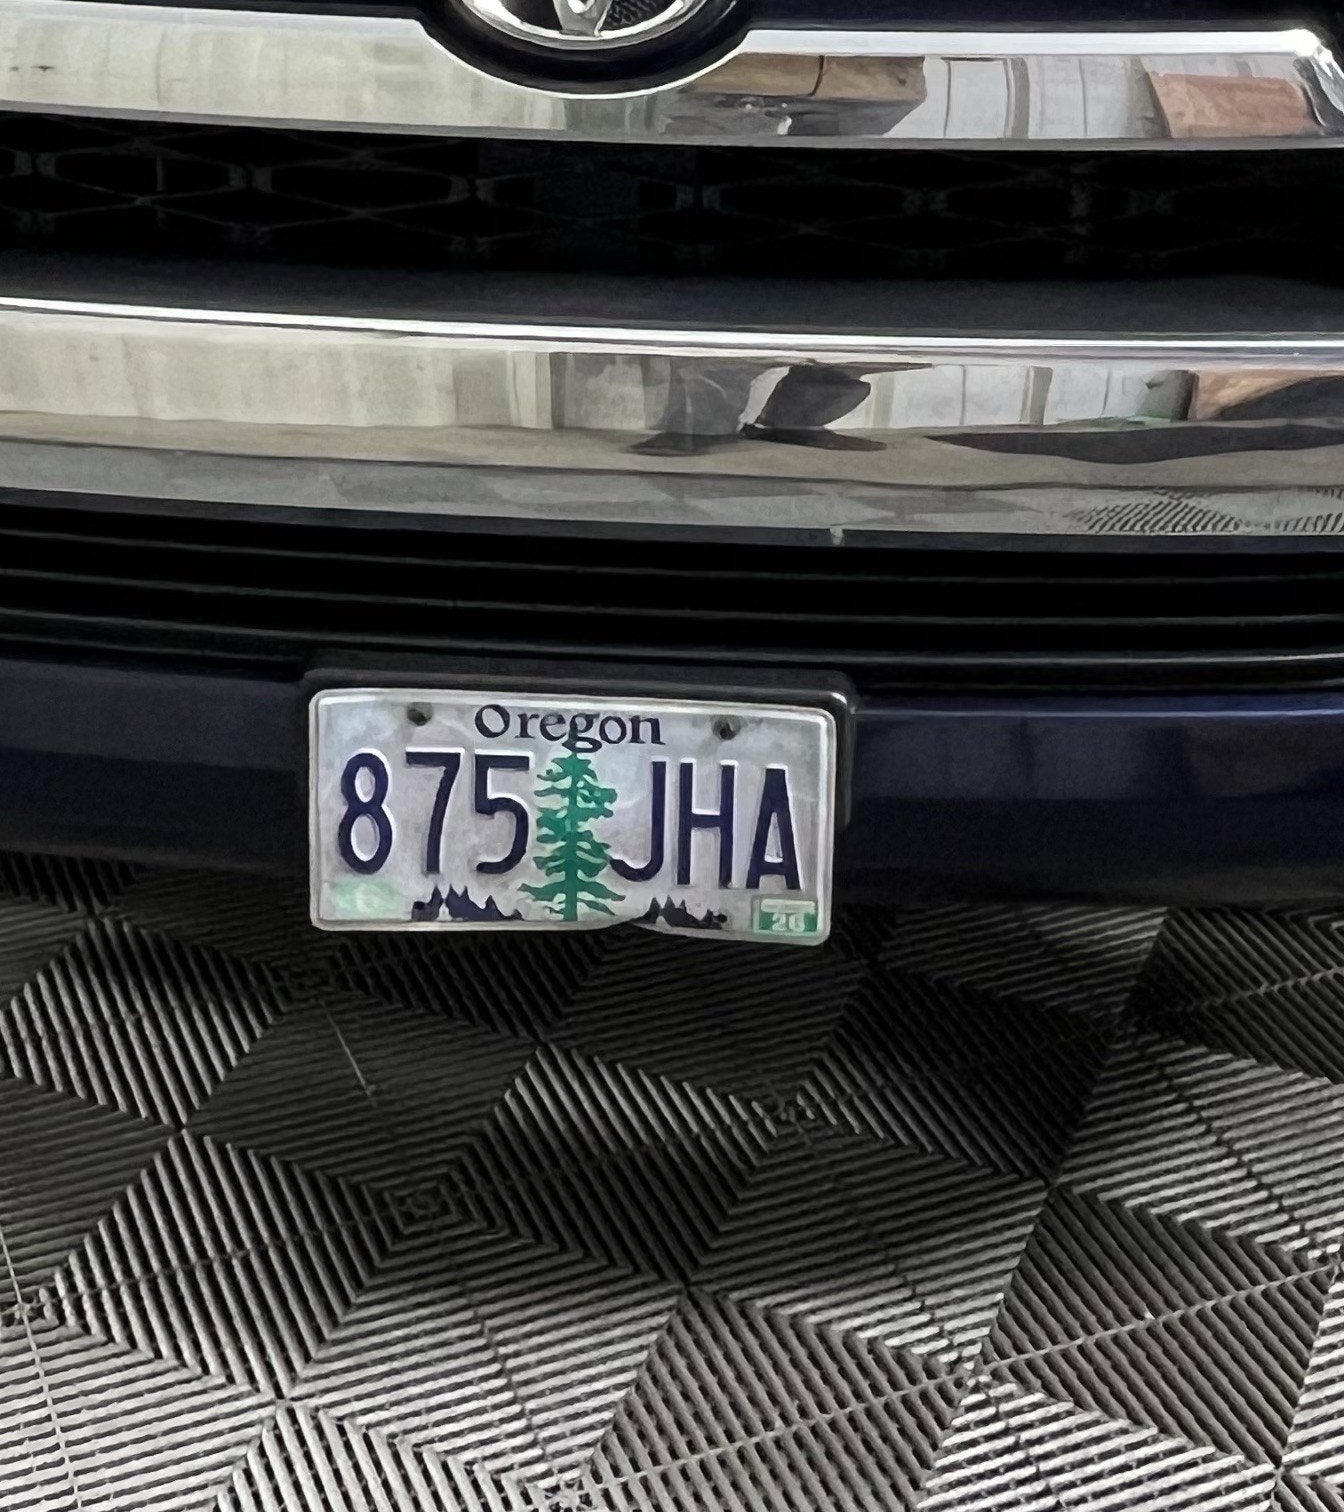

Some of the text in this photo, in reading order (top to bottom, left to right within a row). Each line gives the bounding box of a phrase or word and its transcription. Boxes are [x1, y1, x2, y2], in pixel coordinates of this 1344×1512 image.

[473, 702, 666, 753] Oregon
[337, 750, 802, 890] 875 JHA
